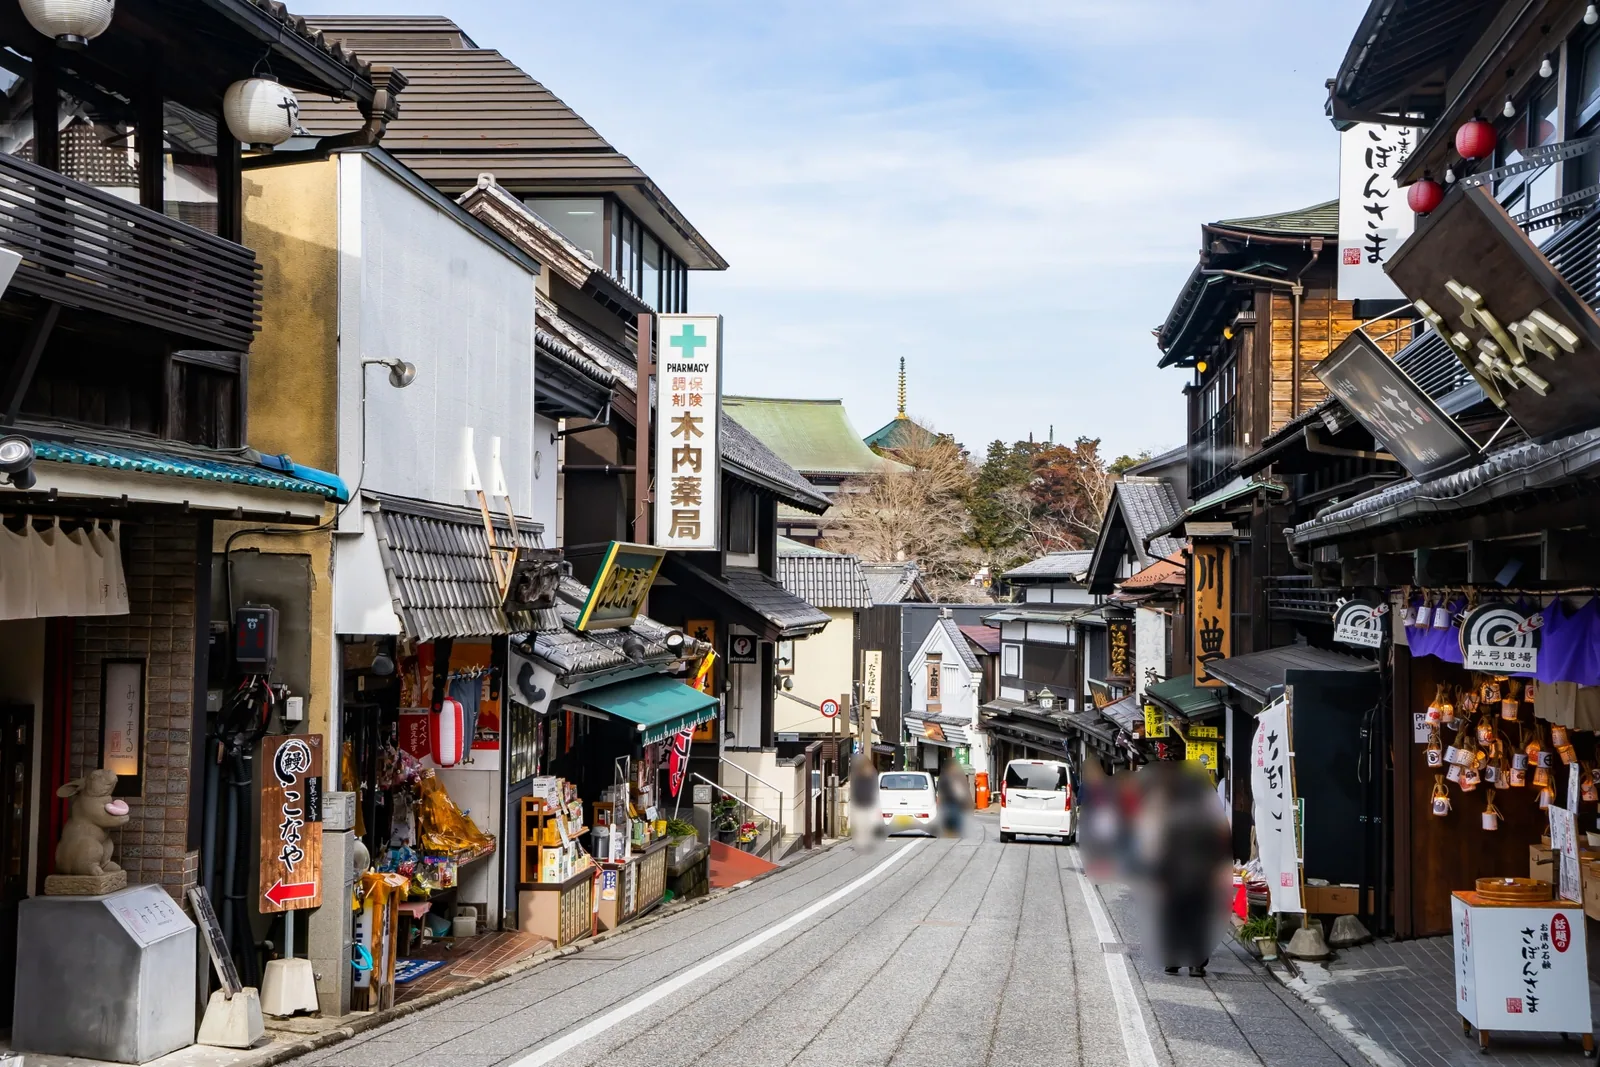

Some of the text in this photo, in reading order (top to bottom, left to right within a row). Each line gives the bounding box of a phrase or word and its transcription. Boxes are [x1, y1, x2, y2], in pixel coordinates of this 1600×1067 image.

[667, 363, 709, 373] PHARMACY
[672, 377, 686, 407] 調剤
[688, 377, 703, 407] 保険
[667, 410, 705, 541] 木内薬局
[1472, 649, 1533, 662] 半弓道場
[867, 663, 876, 694] たちばな
[126, 684, 135, 753] みすまる
[824, 703, 835, 713] 20
[419, 717, 427, 746] ペイペイ
[279, 791, 303, 872] こなや
[1540, 923, 1552, 970] お清め石鹸
[1554, 918, 1568, 948] 話題の
[1520, 927, 1540, 1014] さぼんさま
